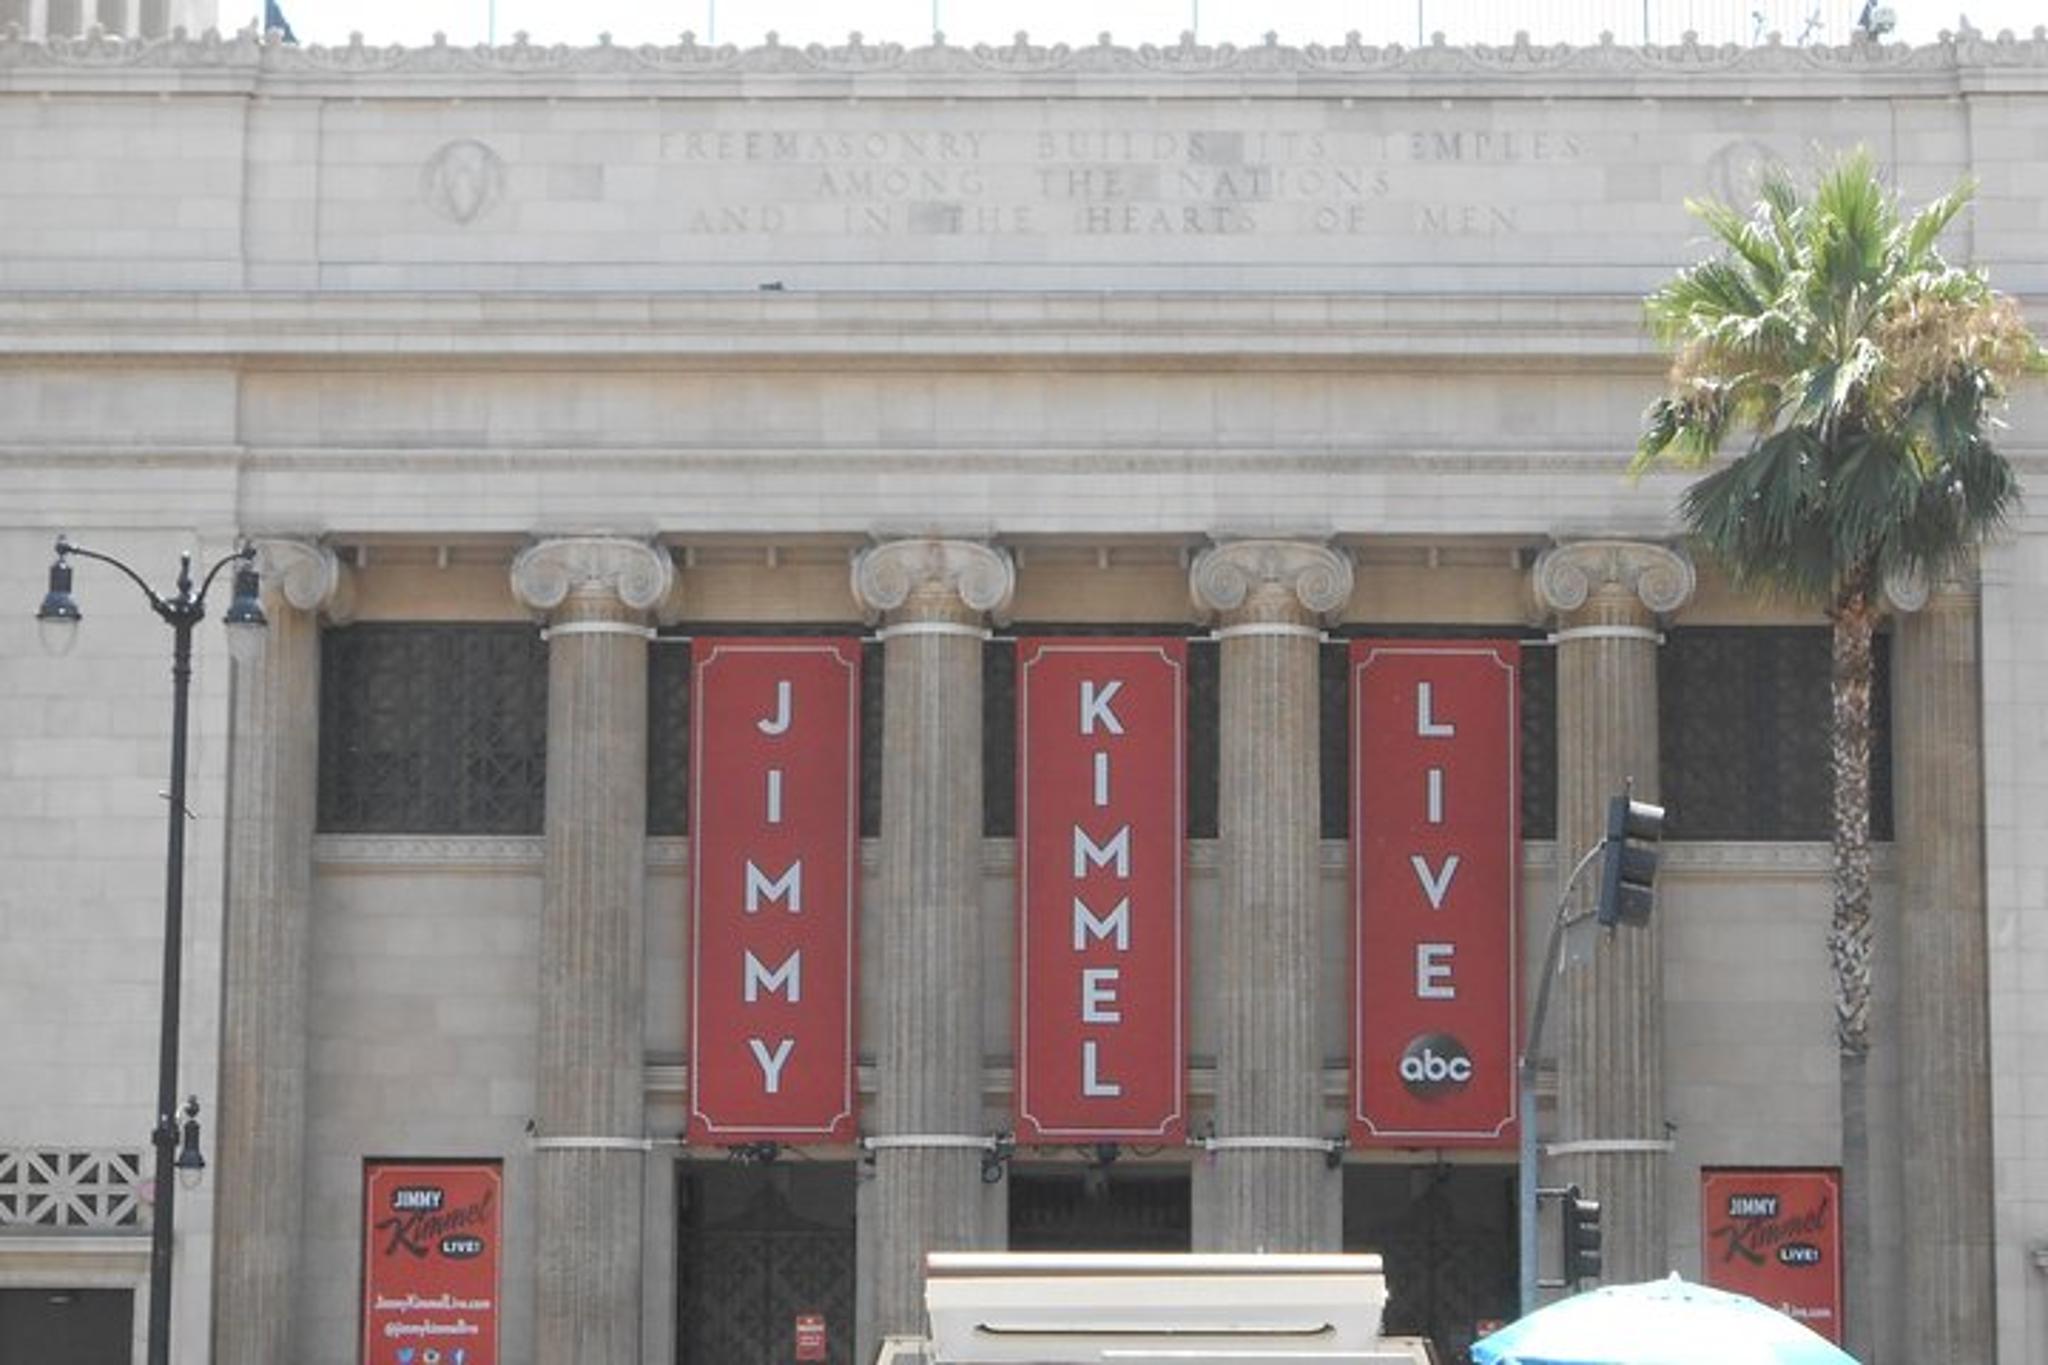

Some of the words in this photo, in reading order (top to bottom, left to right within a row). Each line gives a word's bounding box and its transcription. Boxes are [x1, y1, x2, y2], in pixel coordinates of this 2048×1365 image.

[659, 130, 986, 160] FREEMASONRY
[1036, 130, 1208, 162] BUILDS
[1259, 130, 1326, 161] ITS
[1378, 131, 1583, 162] TEMPLES
[814, 168, 985, 198] AMONG
[1036, 168, 1126, 198] THE
[1177, 168, 1391, 198] NATIONS
[688, 205, 786, 234] AND
[844, 205, 892, 234] IN
[940, 205, 1033, 234] THE
[1086, 205, 1257, 235] HEARTS
[1314, 206, 1368, 235] OF
[1417, 206, 1519, 235] MEN
[1412, 682, 1459, 998] LIVE
[745, 681, 801, 1093] JIMMY
[1074, 681, 1129, 1096] KIMMEL
[1400, 1048, 1472, 1081] abc
[394, 1190, 441, 1207] JIMMY
[1729, 1198, 1775, 1216] JIMMY
